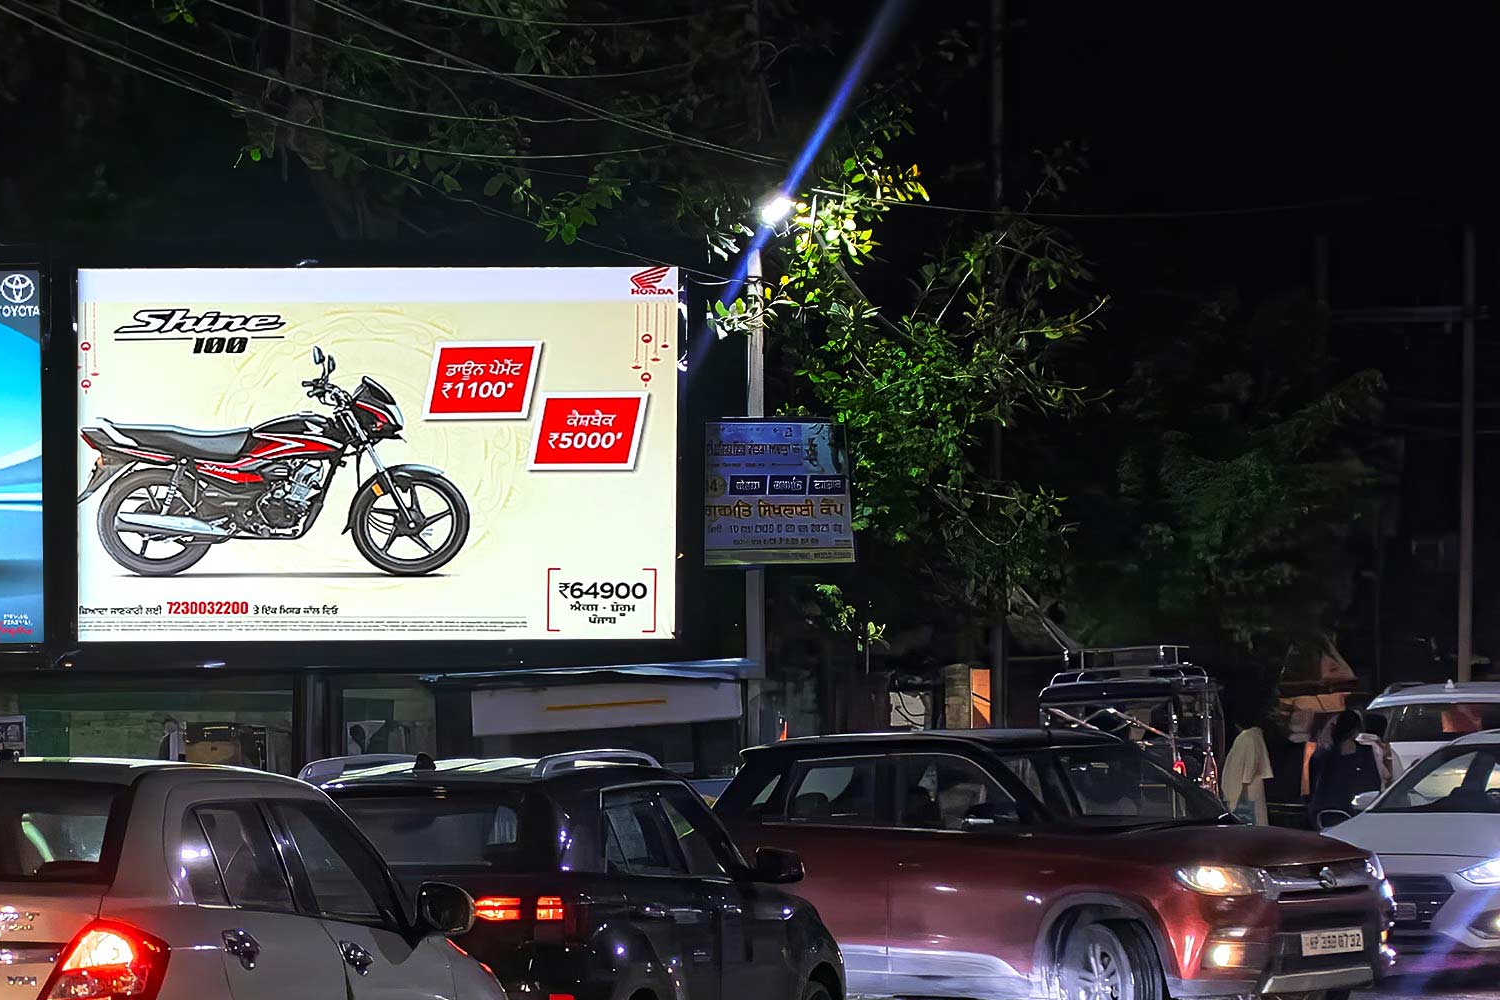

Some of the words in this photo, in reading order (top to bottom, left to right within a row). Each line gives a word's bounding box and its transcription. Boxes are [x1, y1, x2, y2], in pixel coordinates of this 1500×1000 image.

[630, 288, 675, 296] HONDA
[113, 308, 287, 334] Shine
[192, 336, 249, 355] 100
[558, 581, 648, 600] ₹64900
[166, 600, 249, 616] 7230032200
